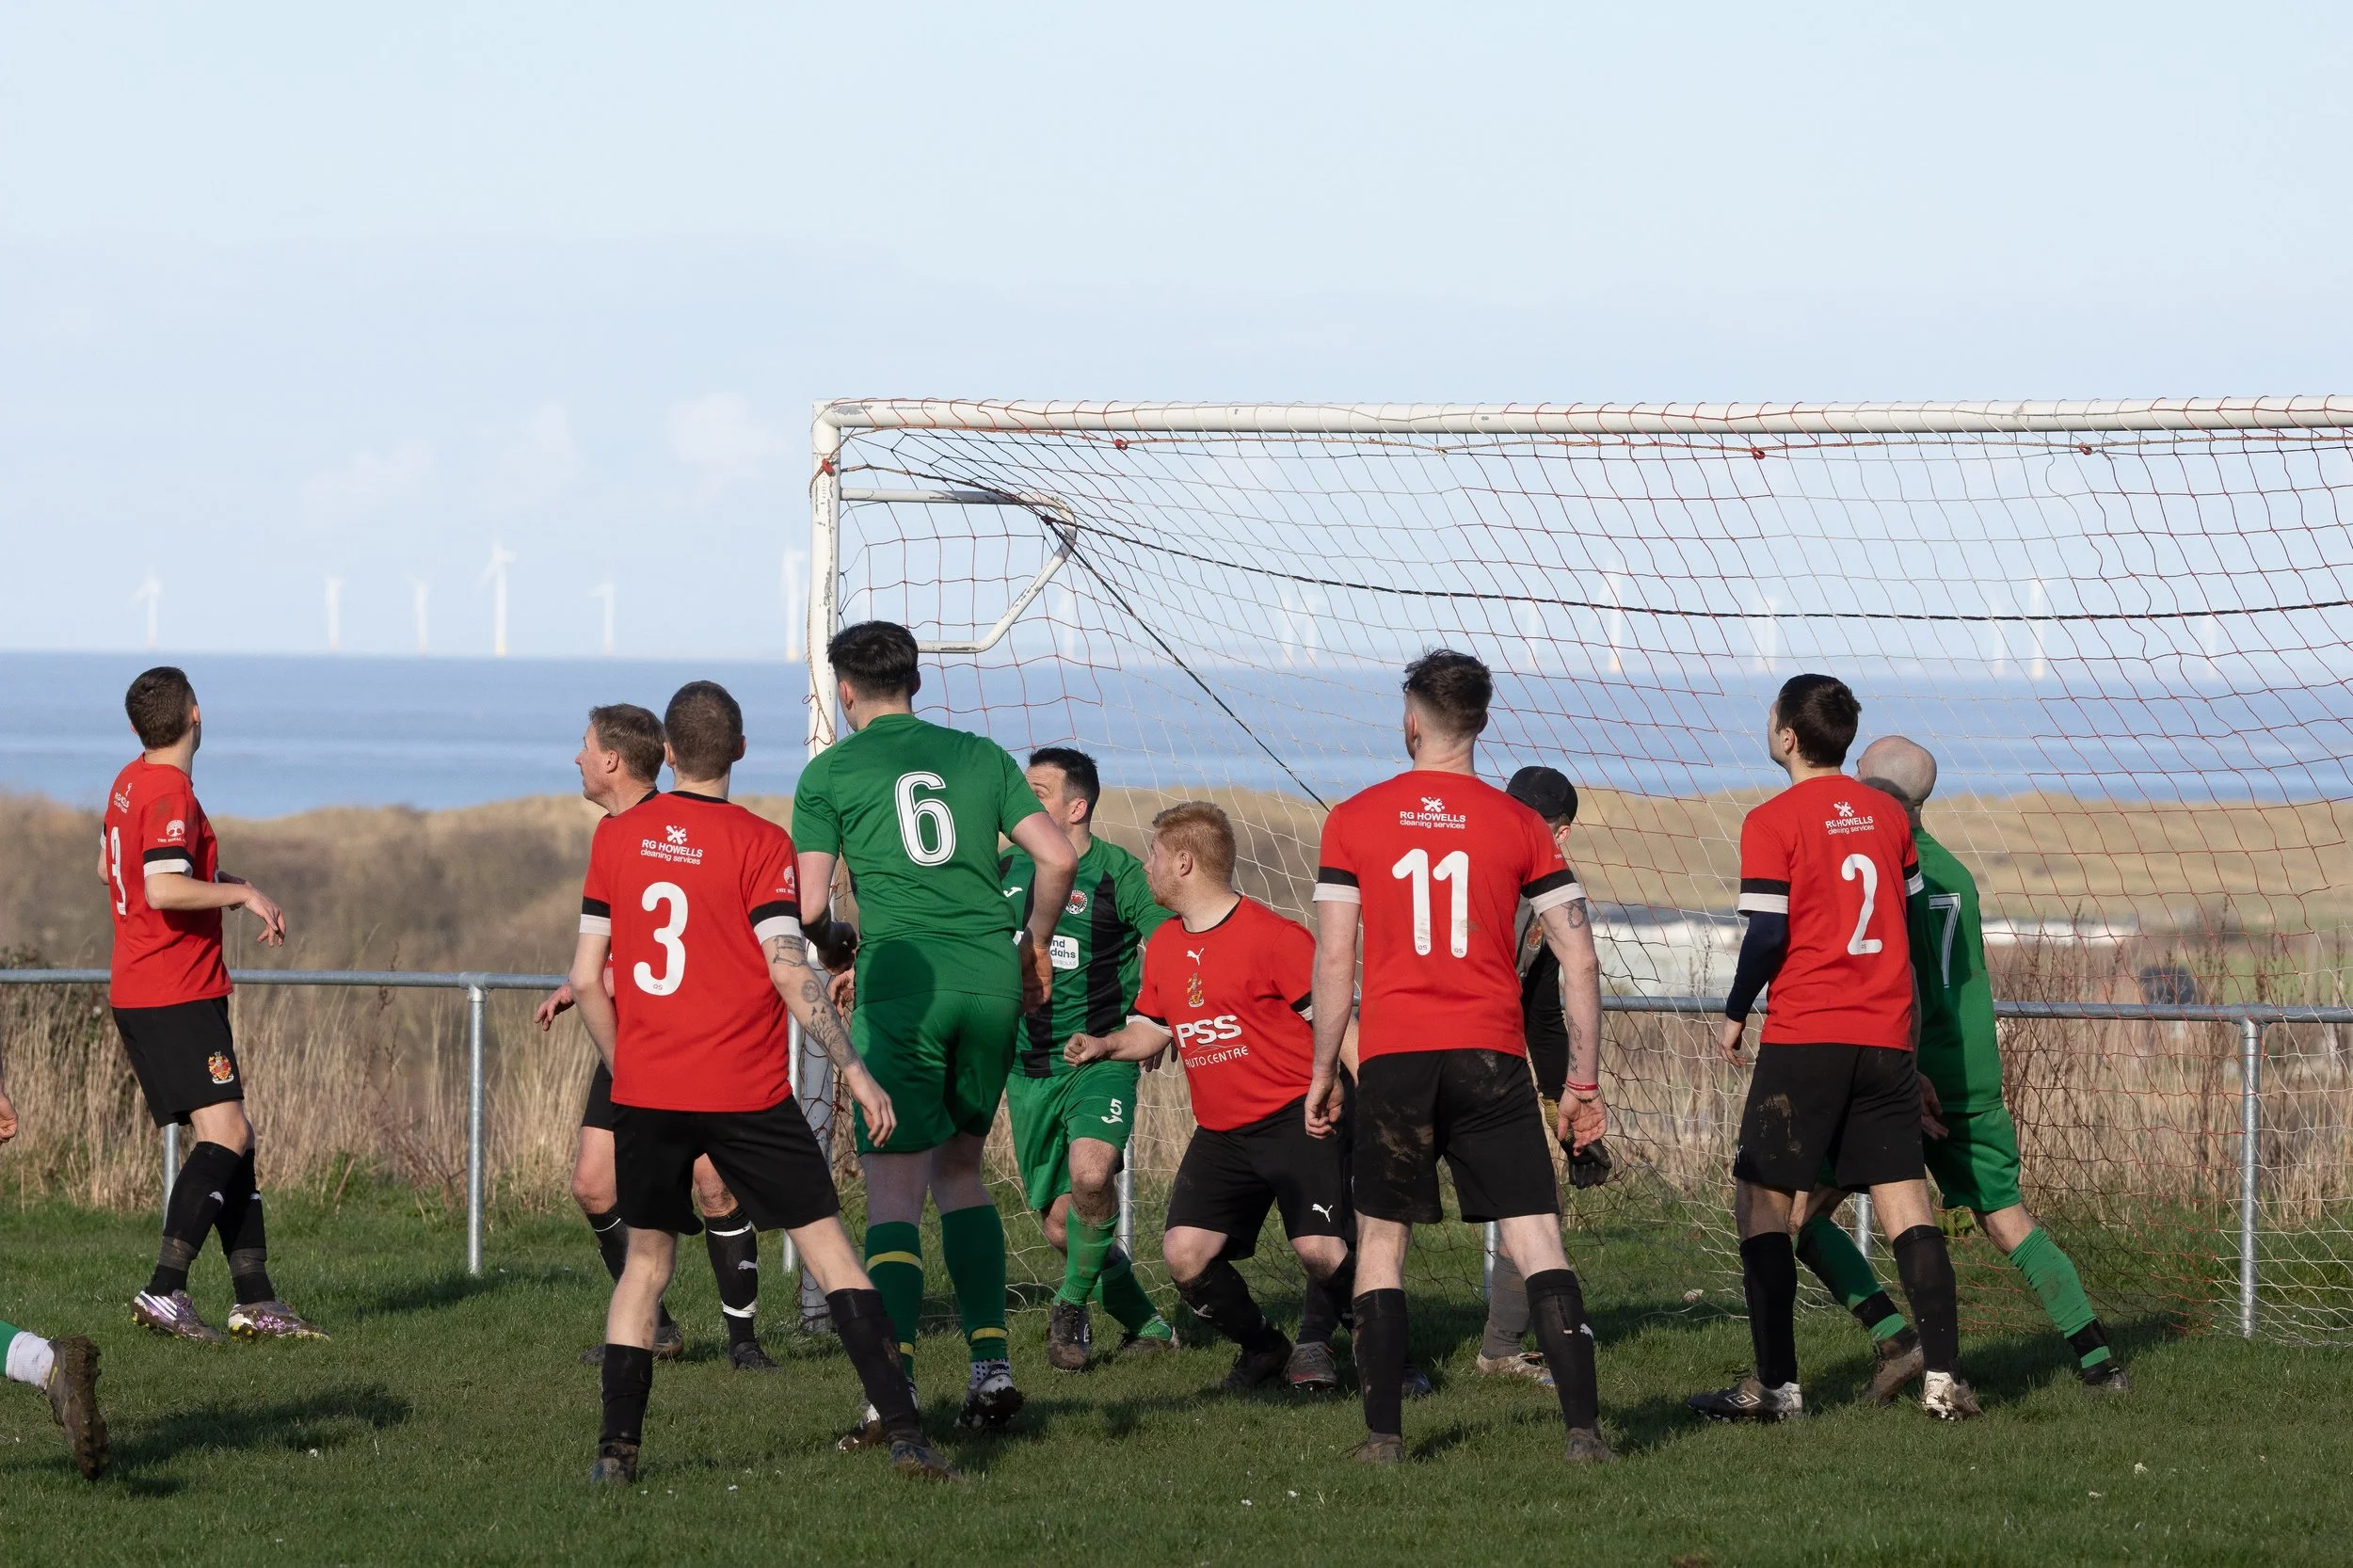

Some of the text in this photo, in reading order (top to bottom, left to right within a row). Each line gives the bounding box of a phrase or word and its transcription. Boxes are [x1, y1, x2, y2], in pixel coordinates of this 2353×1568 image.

[895, 771, 956, 866] 6
[1400, 810, 1466, 823] RG HOWELLS
[1400, 818, 1465, 829] cleaning services
[1836, 815, 1874, 827] HOWELLS
[640, 848, 701, 865] cleaning services
[641, 839, 703, 857] RG HOWELLS
[1392, 848, 1469, 959] 11
[1841, 853, 1882, 955] 2
[633, 881, 689, 997] 3
[1052, 938, 1065, 948] nd
[1929, 893, 1961, 988] 7
[1050, 947, 1077, 958] dahs
[1175, 1015, 1243, 1049] PSS
[1184, 1045, 1250, 1068] AUTO CENTRE
[1110, 1097, 1123, 1116] 5
